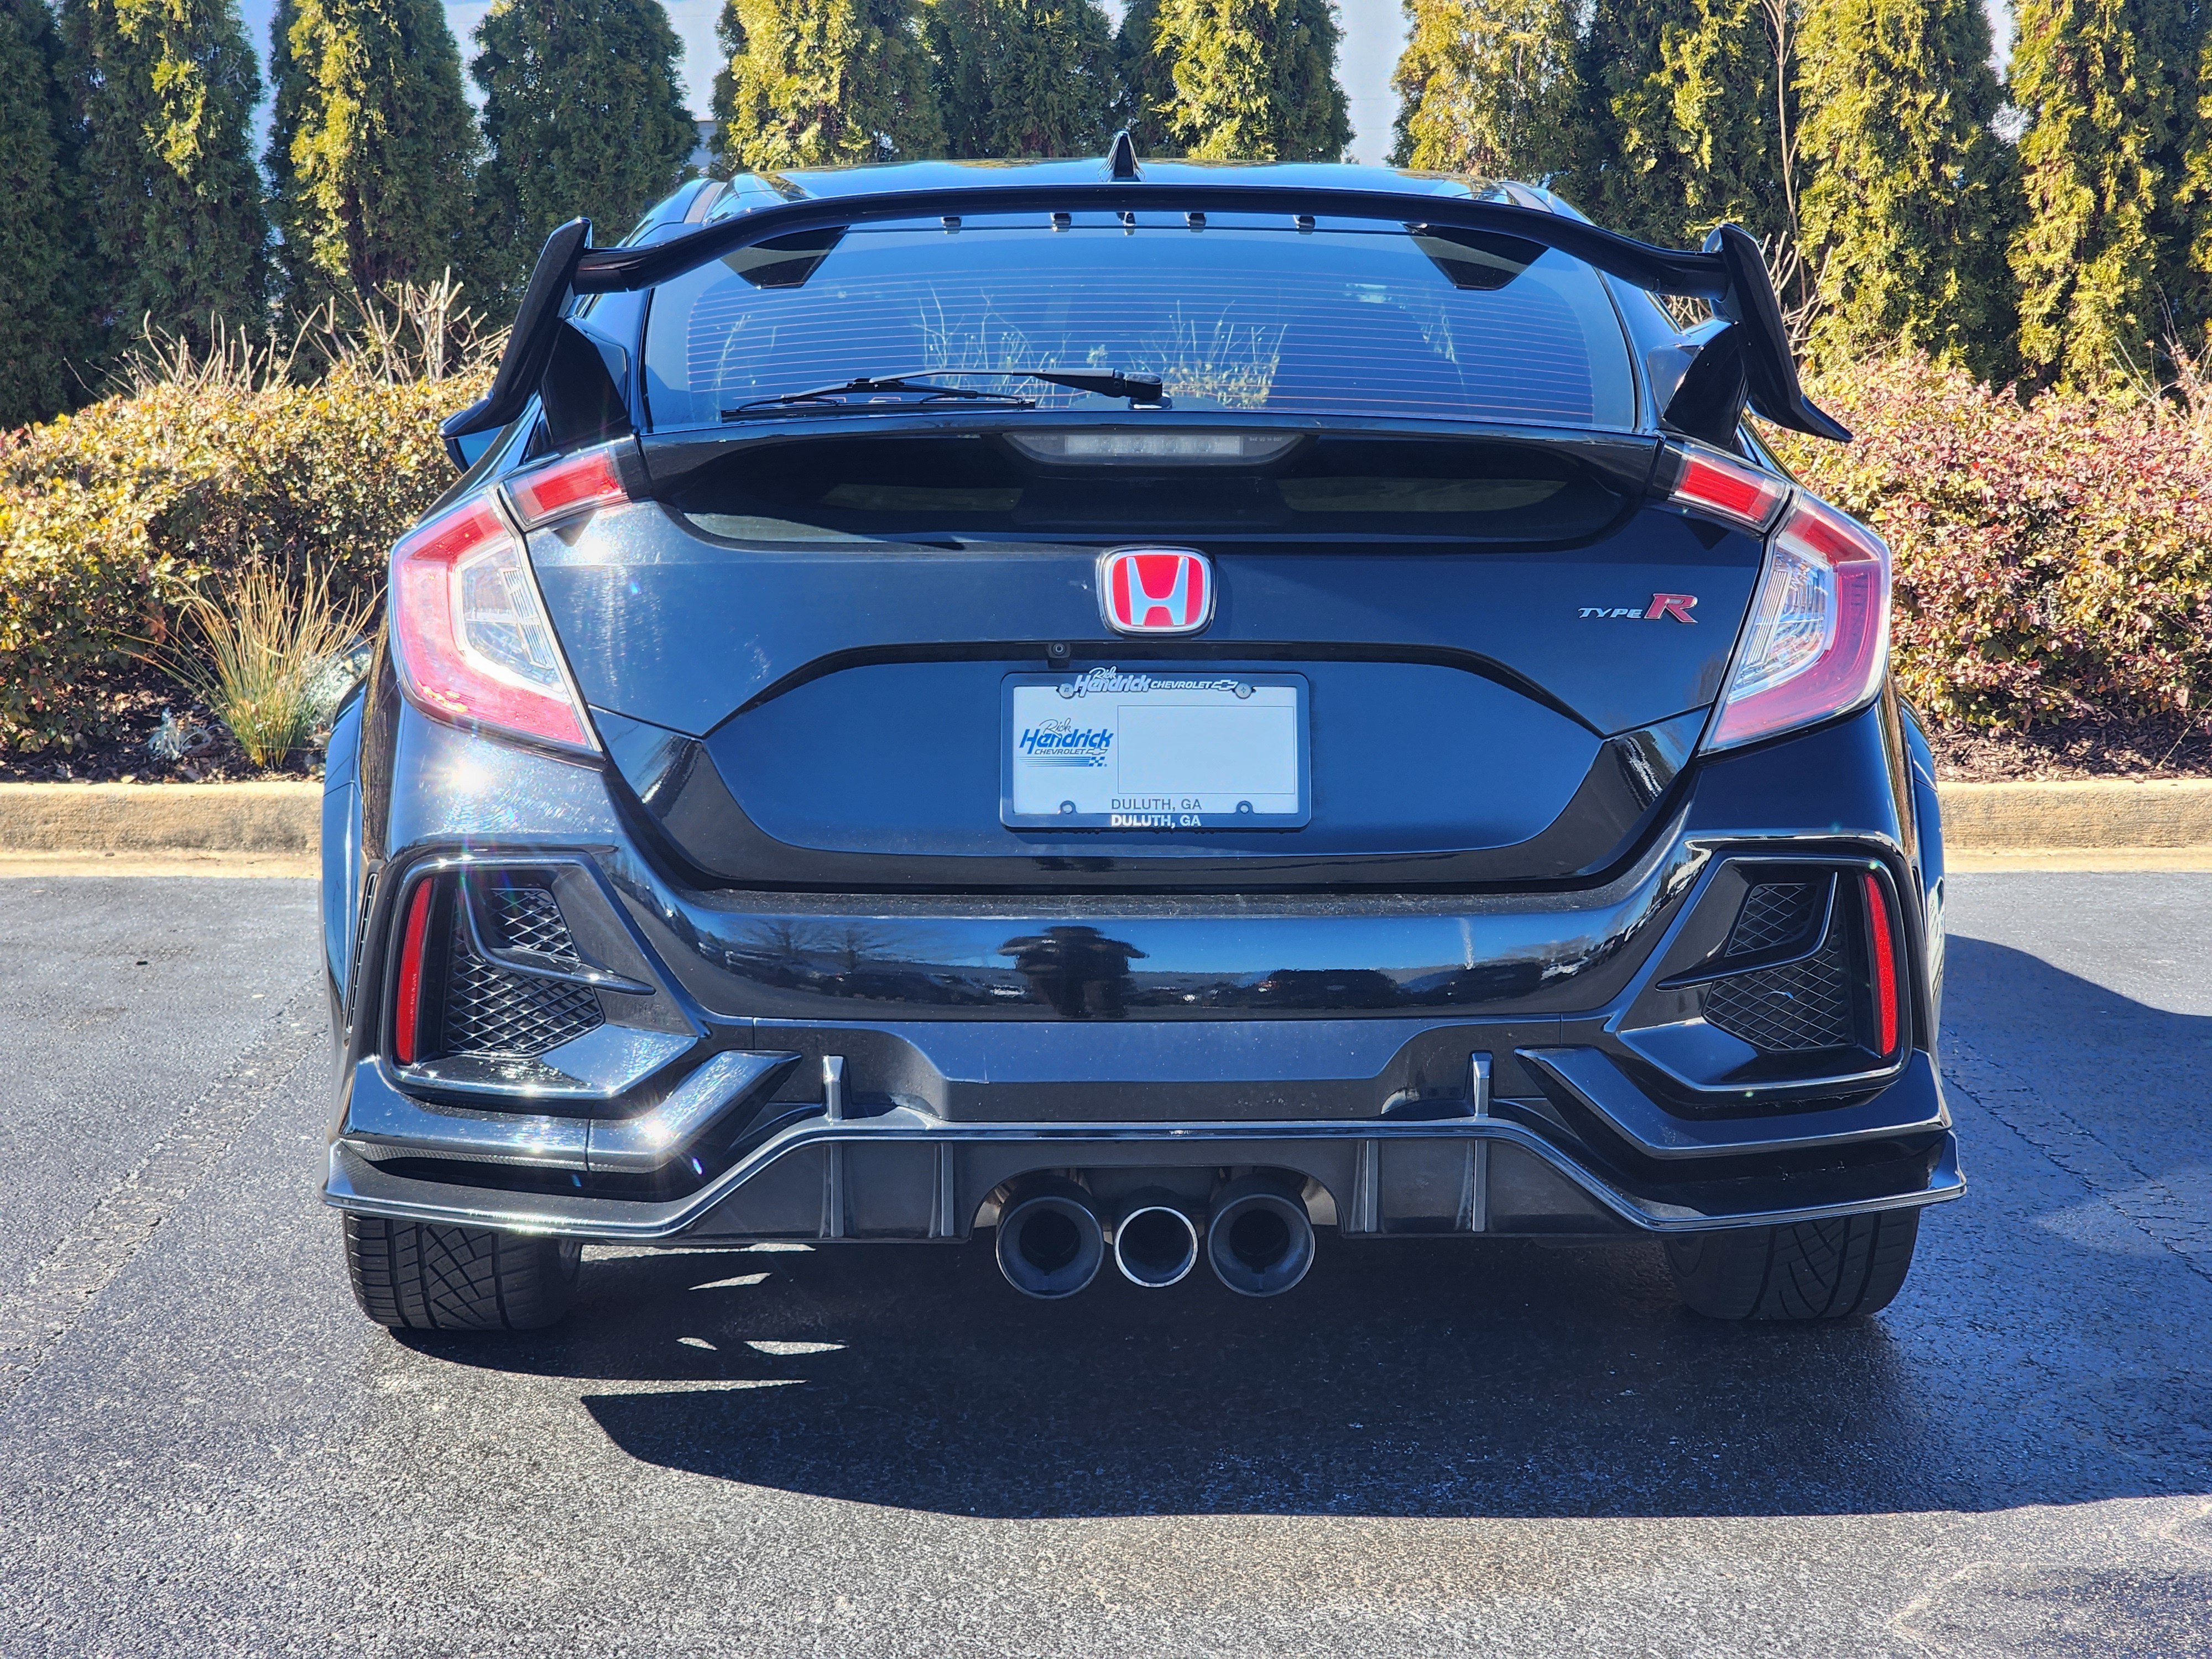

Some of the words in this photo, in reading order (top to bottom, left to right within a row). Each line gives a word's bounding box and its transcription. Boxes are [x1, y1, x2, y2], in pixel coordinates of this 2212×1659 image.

[1578, 608, 1643, 619] TYPE
[1644, 593, 1698, 623] R
[1089, 666, 1117, 681] Rick
[1074, 674, 1152, 697] Hendrick
[1150, 680, 1213, 689] CHEVROLET
[1039, 717, 1072, 739] Rick
[1019, 728, 1114, 755] Hendrick
[1111, 799, 1176, 812] DULUTH,
[1181, 799, 1202, 810] GA
[1111, 814, 1176, 829] DULUTH,
[1180, 814, 1202, 827] GA
